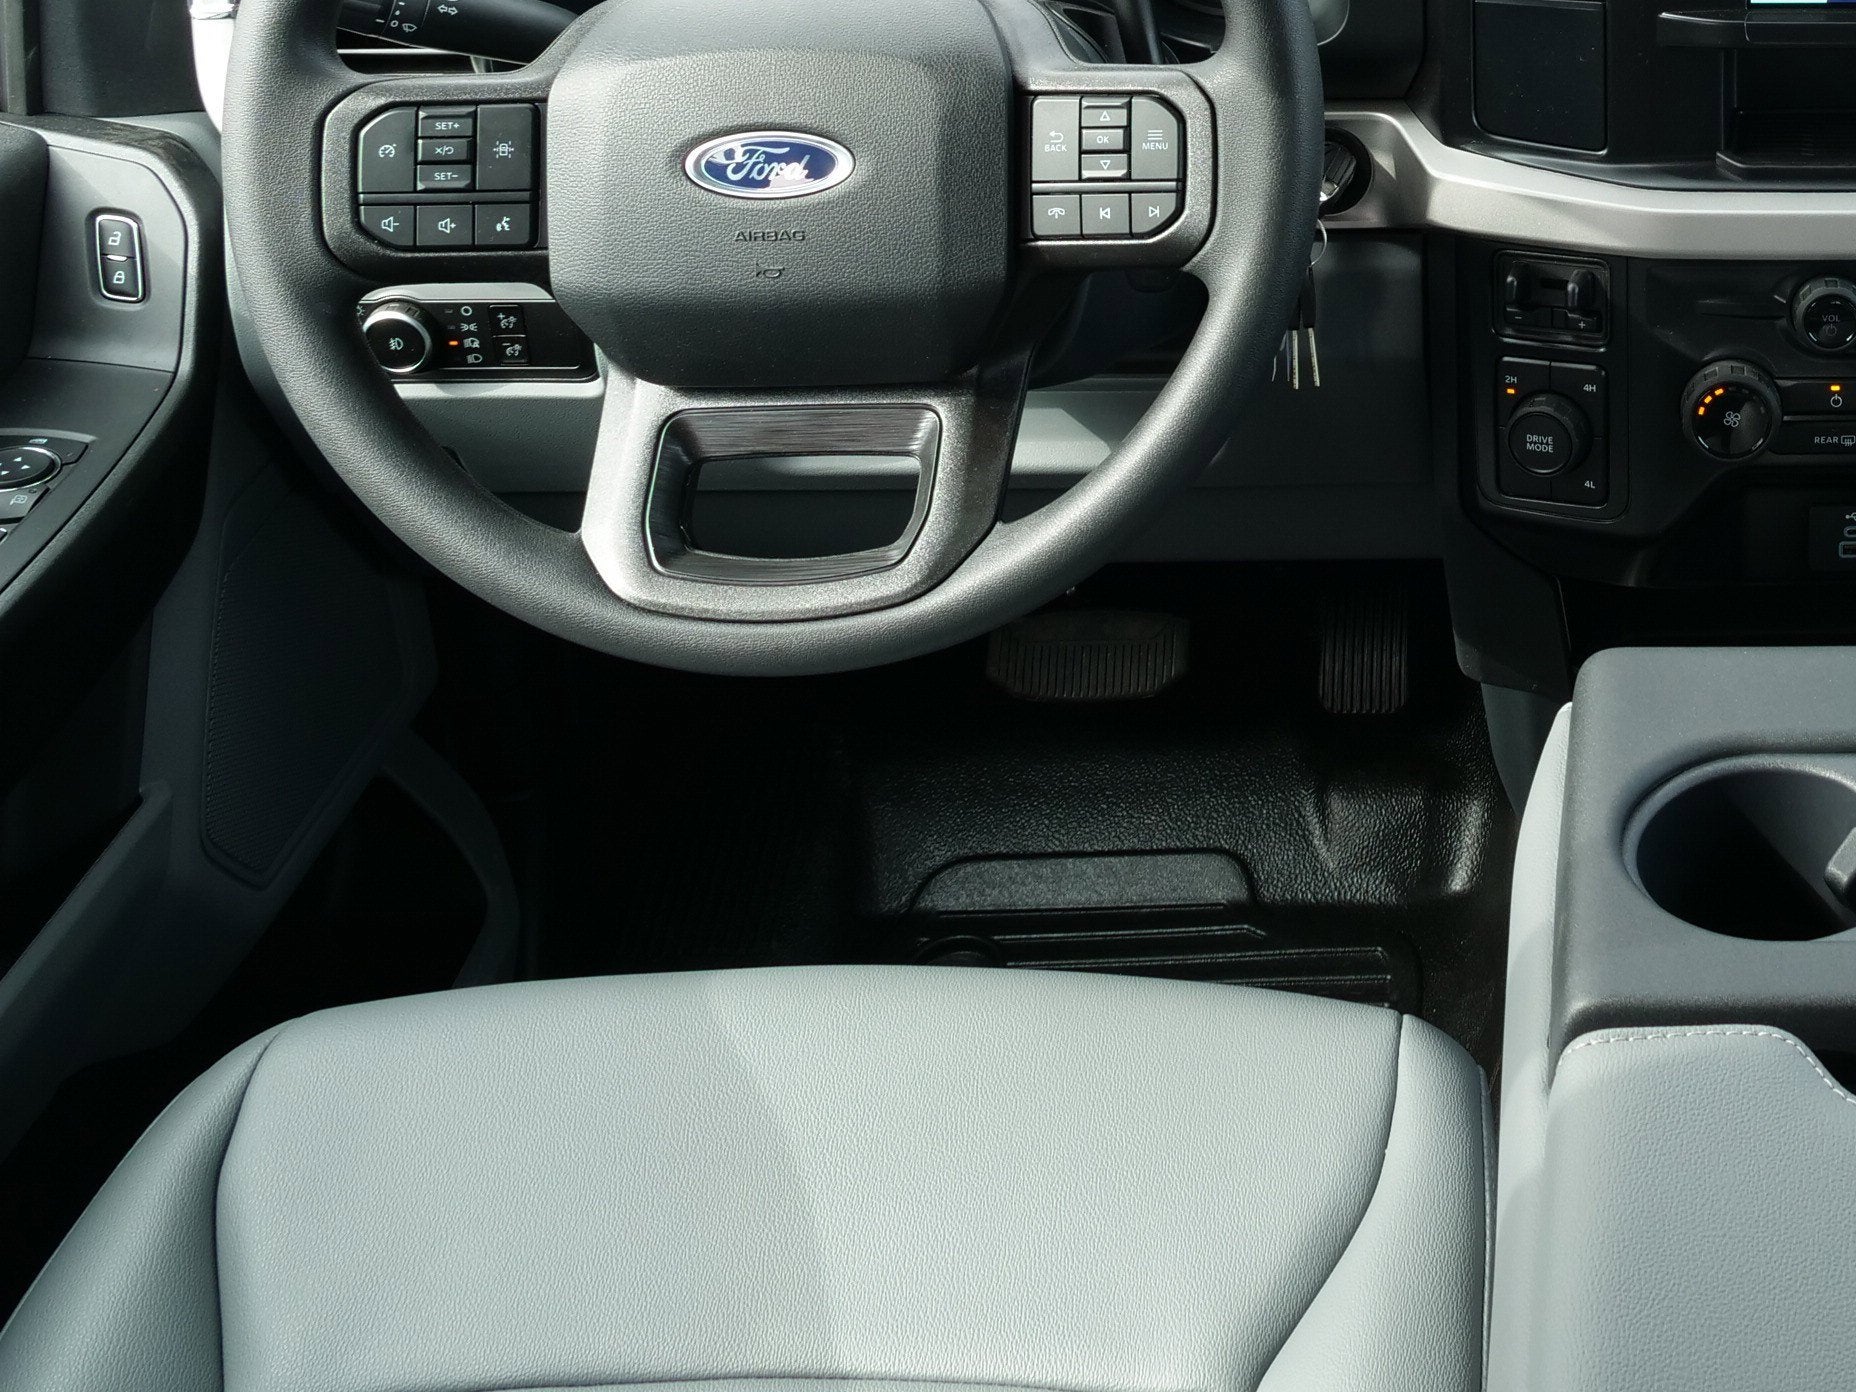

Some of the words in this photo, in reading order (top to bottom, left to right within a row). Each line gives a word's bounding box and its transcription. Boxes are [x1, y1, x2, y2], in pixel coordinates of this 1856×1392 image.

[1096, 136, 1109, 144] OK
[1044, 143, 1068, 153] BACK
[1142, 142, 1169, 150] MENU
[734, 230, 806, 242] AIRBAG
[1822, 314, 1840, 323] VOL
[1504, 375, 1517, 384] 2H
[1583, 384, 1597, 393] 4H
[1526, 434, 1554, 445] DRIVE
[1814, 436, 1839, 444] REAR
[1526, 443, 1554, 453] MODE
[1584, 480, 1595, 490] 4L
